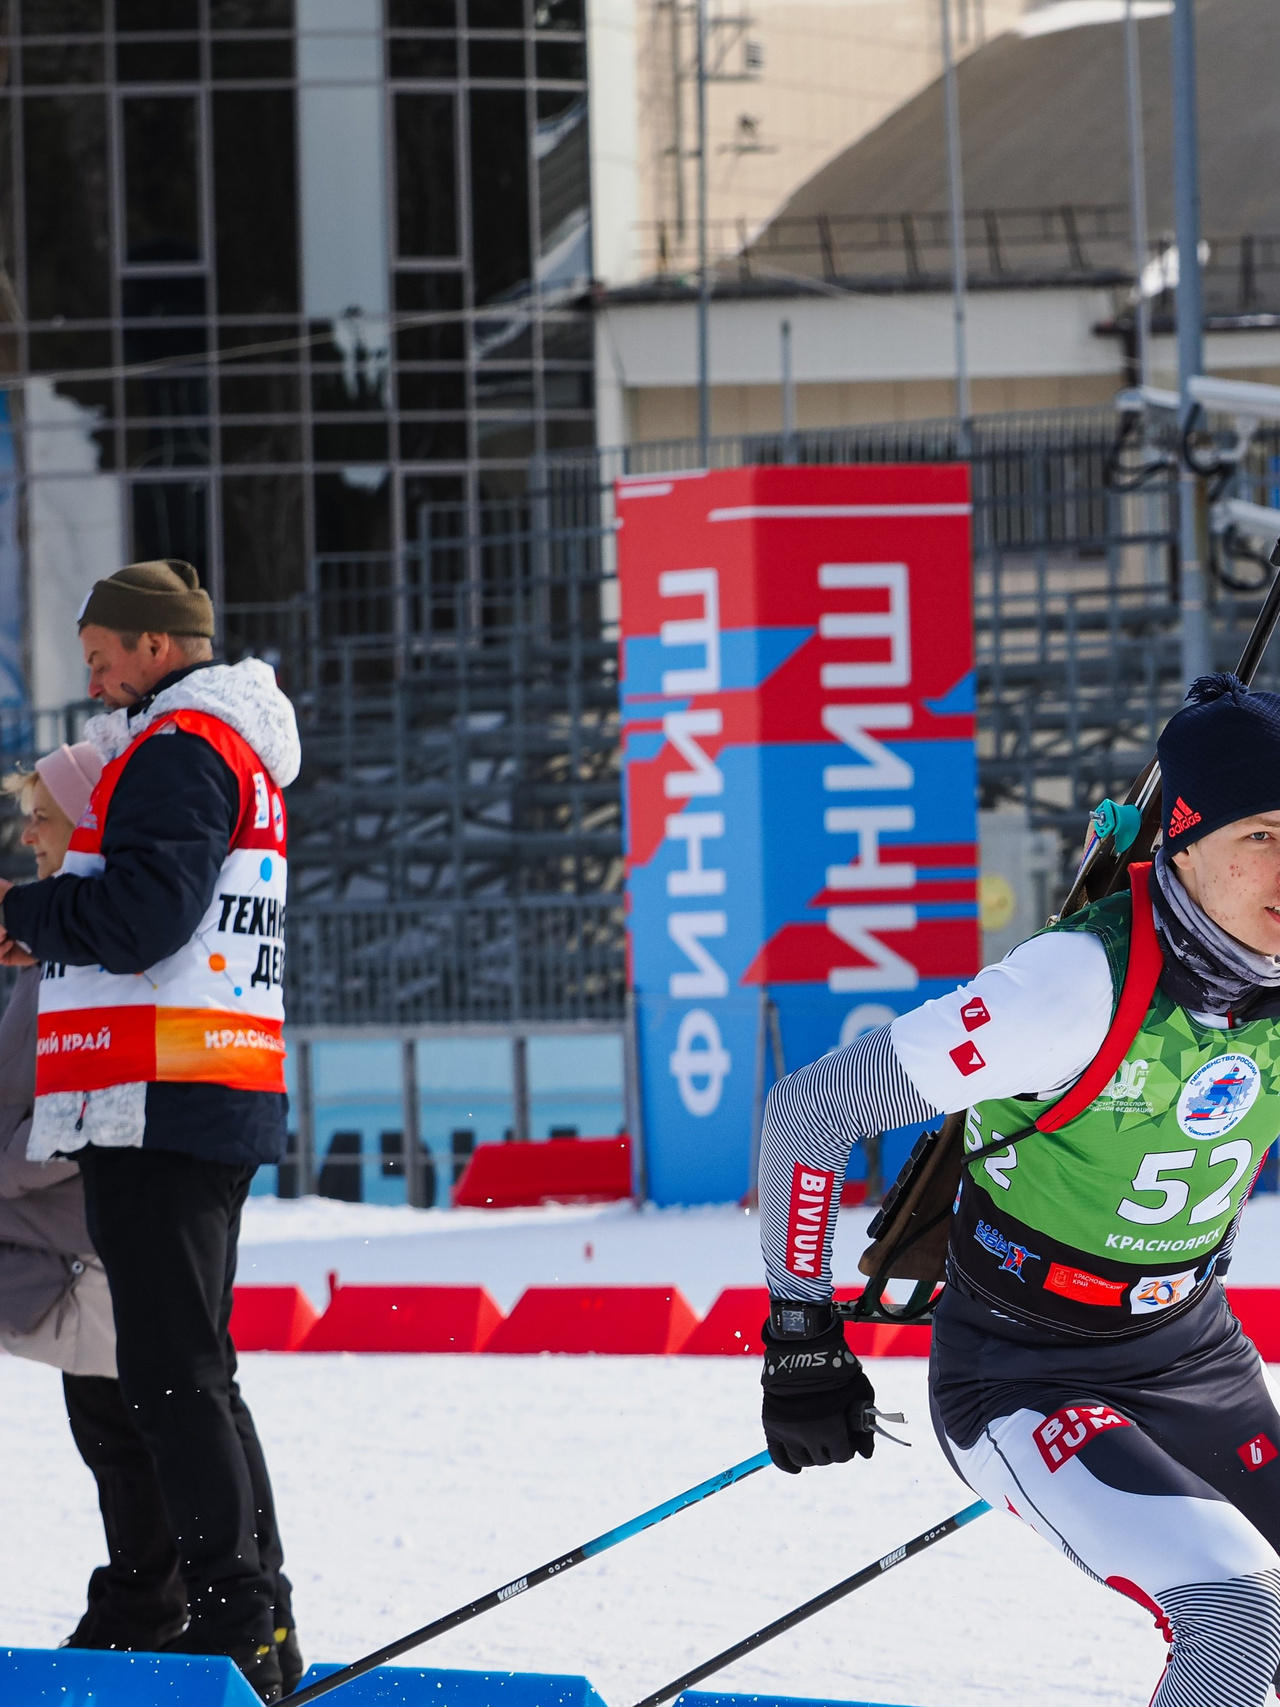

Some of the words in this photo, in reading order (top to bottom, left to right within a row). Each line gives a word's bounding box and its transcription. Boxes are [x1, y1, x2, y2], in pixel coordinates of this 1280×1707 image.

[1167, 809, 1203, 839] adidas
[657, 566, 731, 1117] ФИНИШ
[62, 1026, 111, 1052] КРАЙ
[1189, 1055, 1236, 1086] ПЕРВЕНСТВО
[1236, 1055, 1258, 1077] РОССИИ
[1115, 1138, 1254, 1226] 52
[792, 1171, 827, 1274] BIVIUM
[1104, 1225, 1223, 1252] КРАСНОЯРСК
